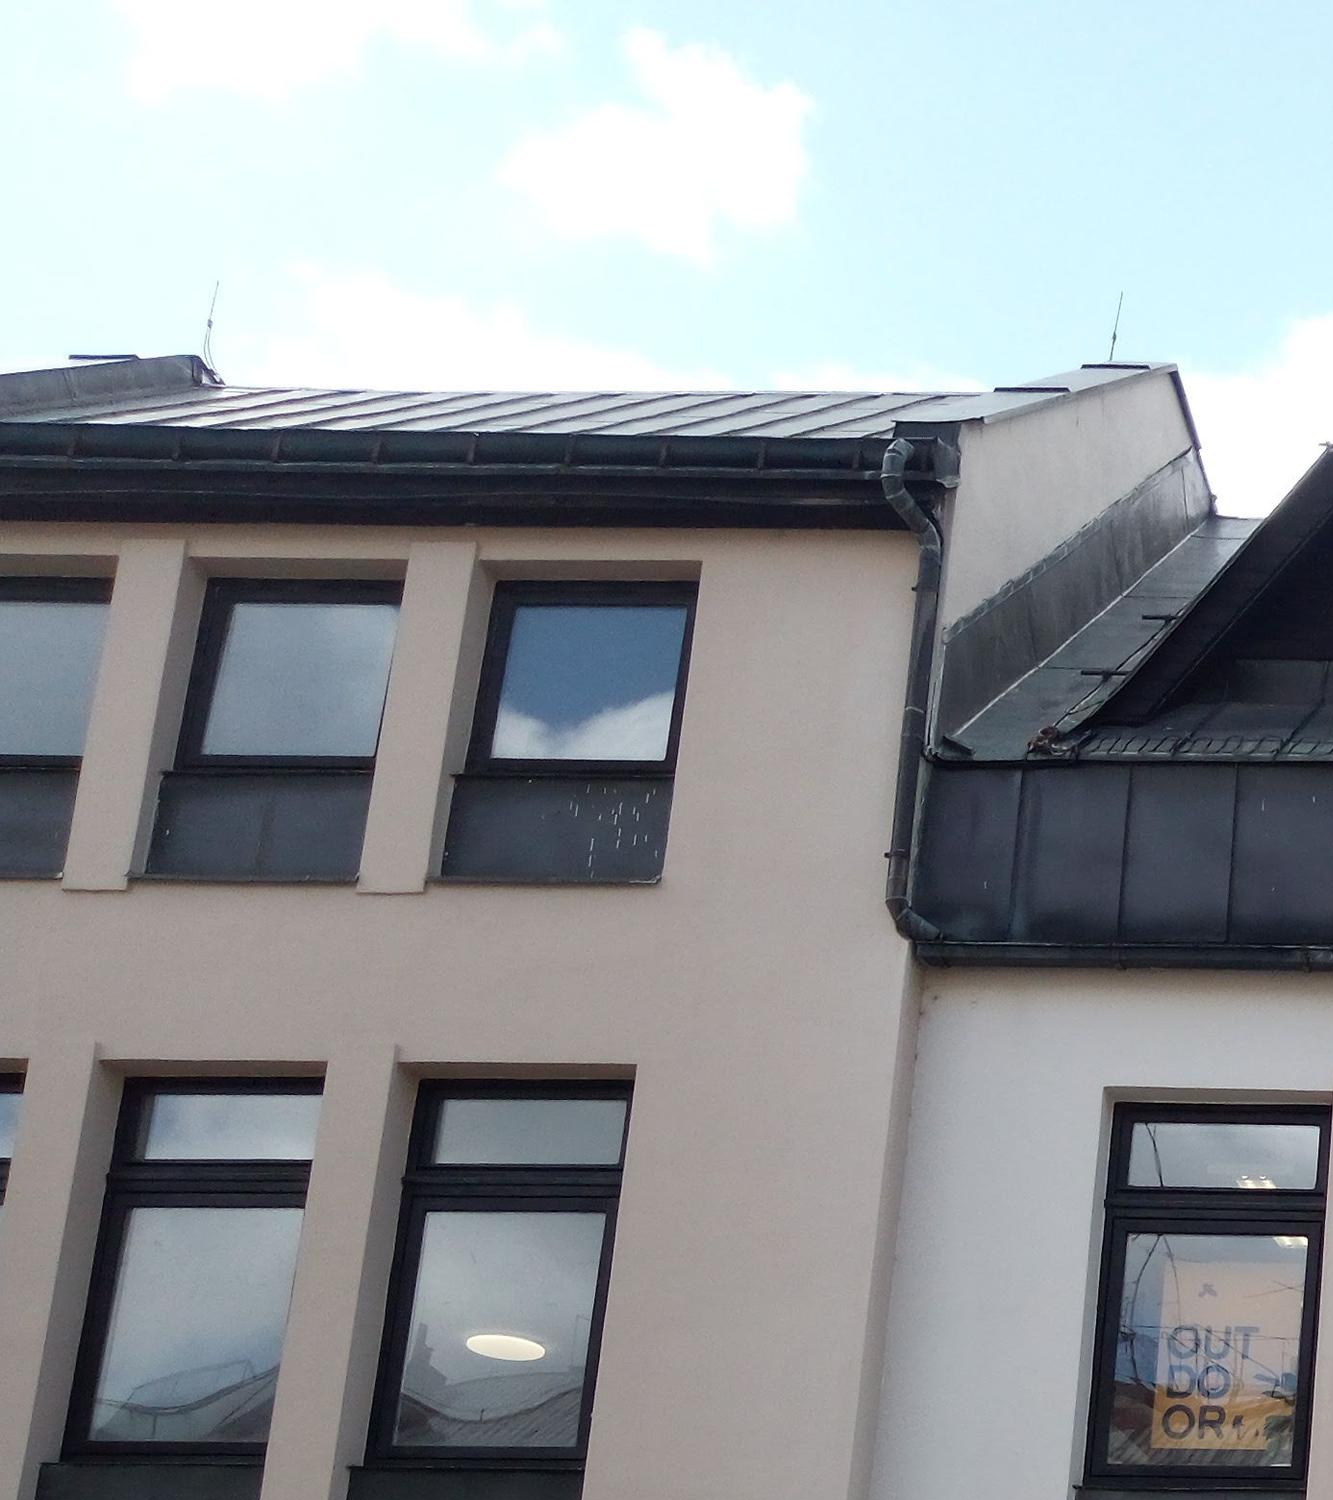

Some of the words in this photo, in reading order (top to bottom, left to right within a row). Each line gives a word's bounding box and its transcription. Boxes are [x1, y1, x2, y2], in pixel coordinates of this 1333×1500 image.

[1169, 1325, 1259, 1360] OUT
[1167, 1364, 1232, 1399] DO
[1162, 1403, 1226, 1440] OR
